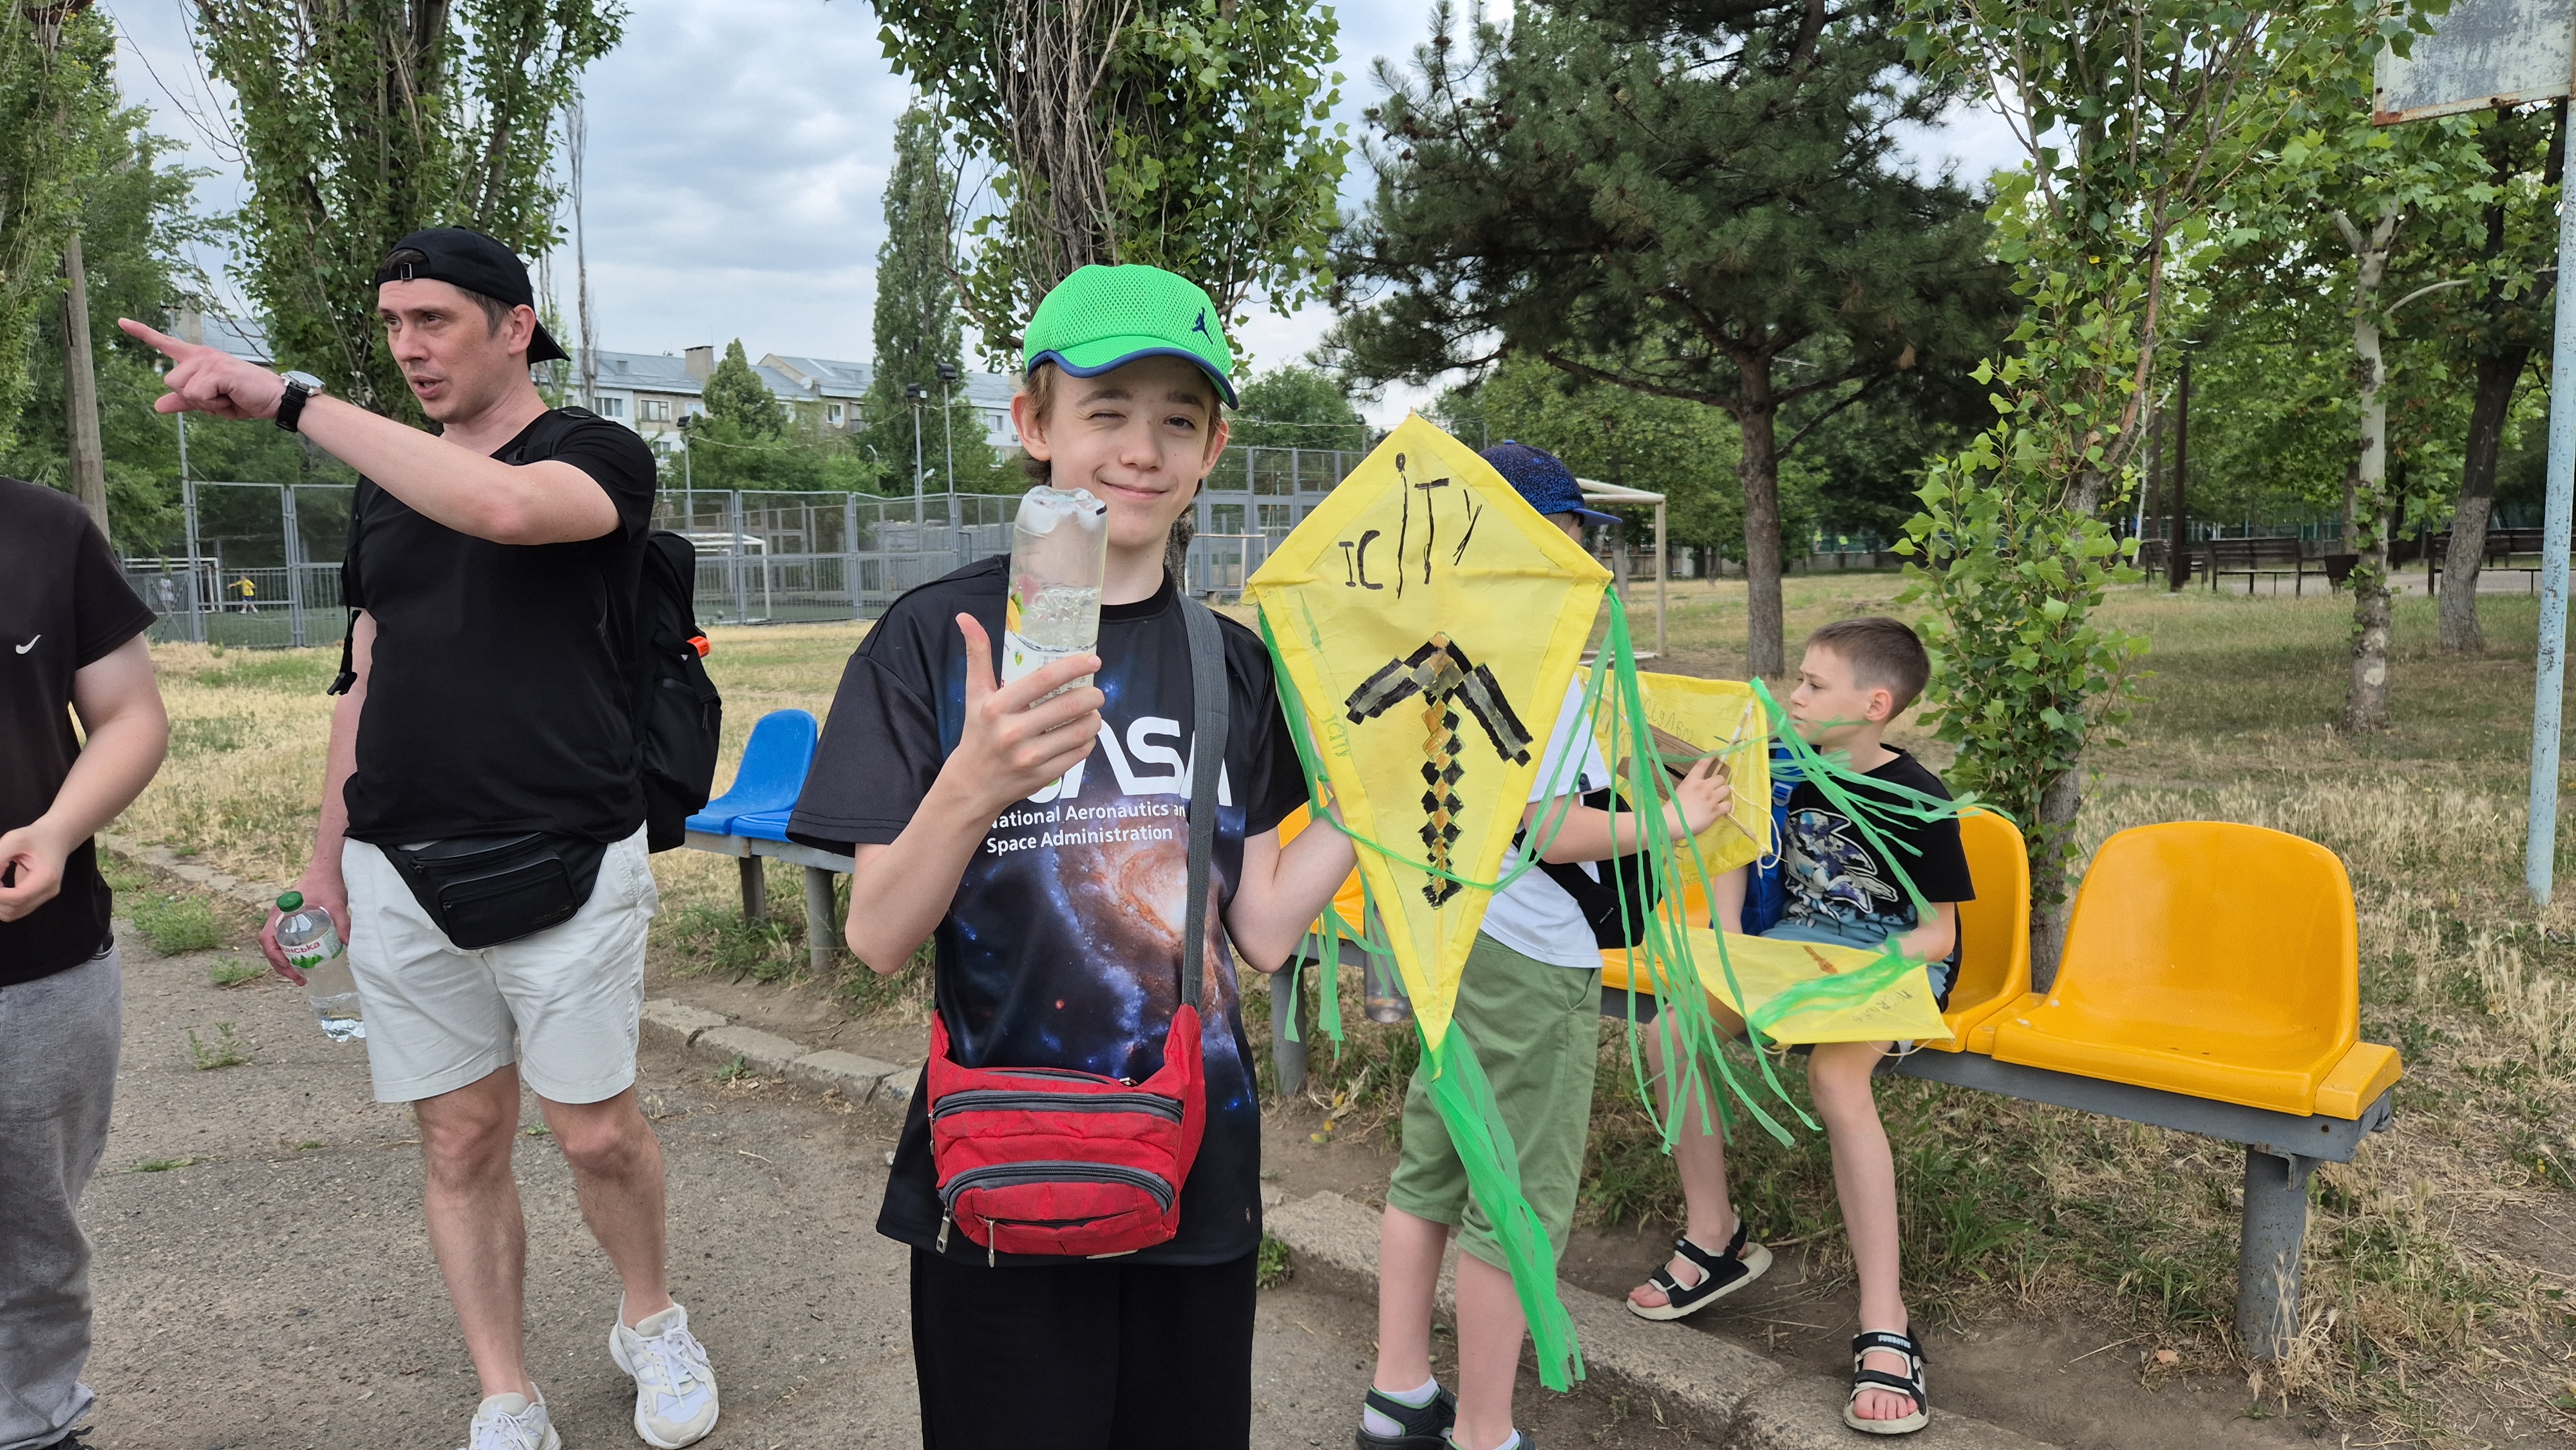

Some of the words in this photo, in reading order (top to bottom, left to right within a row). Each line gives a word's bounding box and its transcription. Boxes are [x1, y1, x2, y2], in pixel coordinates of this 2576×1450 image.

[1066, 802, 1169, 821] Aeronautics
[987, 836, 1037, 856] Space
[1041, 825, 1173, 848] Administration
